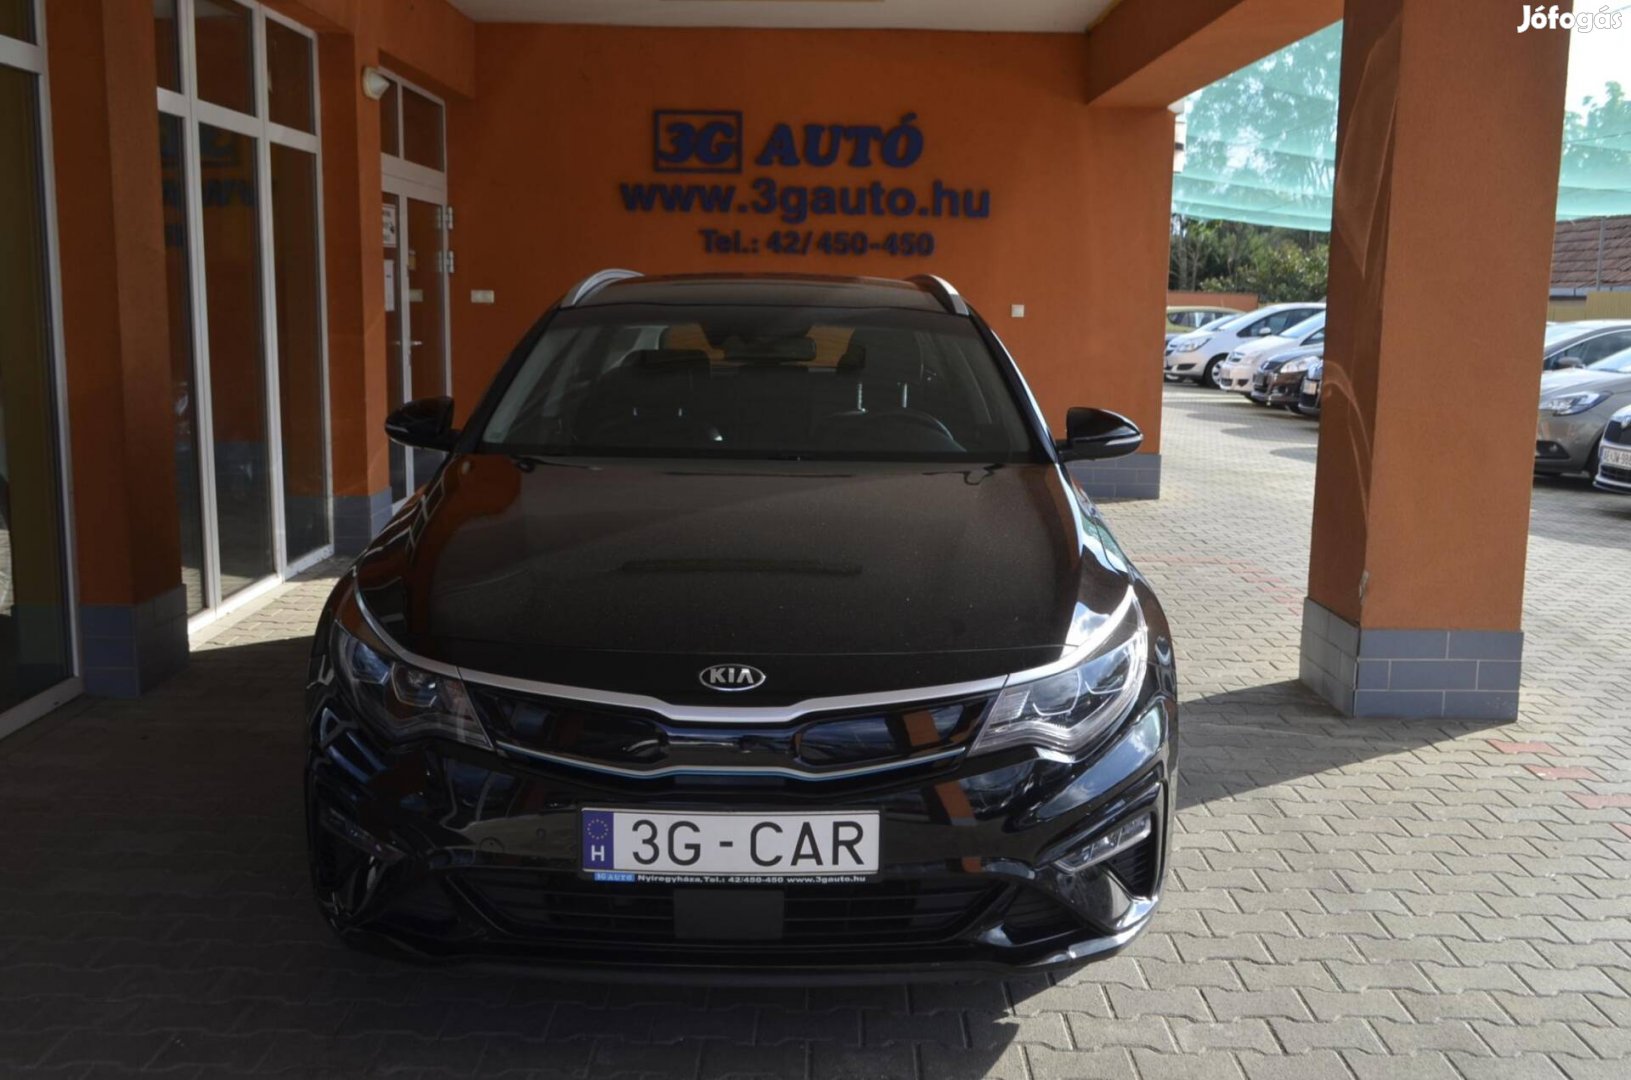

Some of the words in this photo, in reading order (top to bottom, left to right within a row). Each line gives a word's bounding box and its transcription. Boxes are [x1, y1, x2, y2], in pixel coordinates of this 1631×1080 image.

[658, 121, 736, 164] 3G
[755, 112, 924, 168] AUTÓ
[620, 177, 990, 224] www.3gauto.hu
[698, 228, 760, 254] Tel.:
[710, 668, 754, 683] KIA
